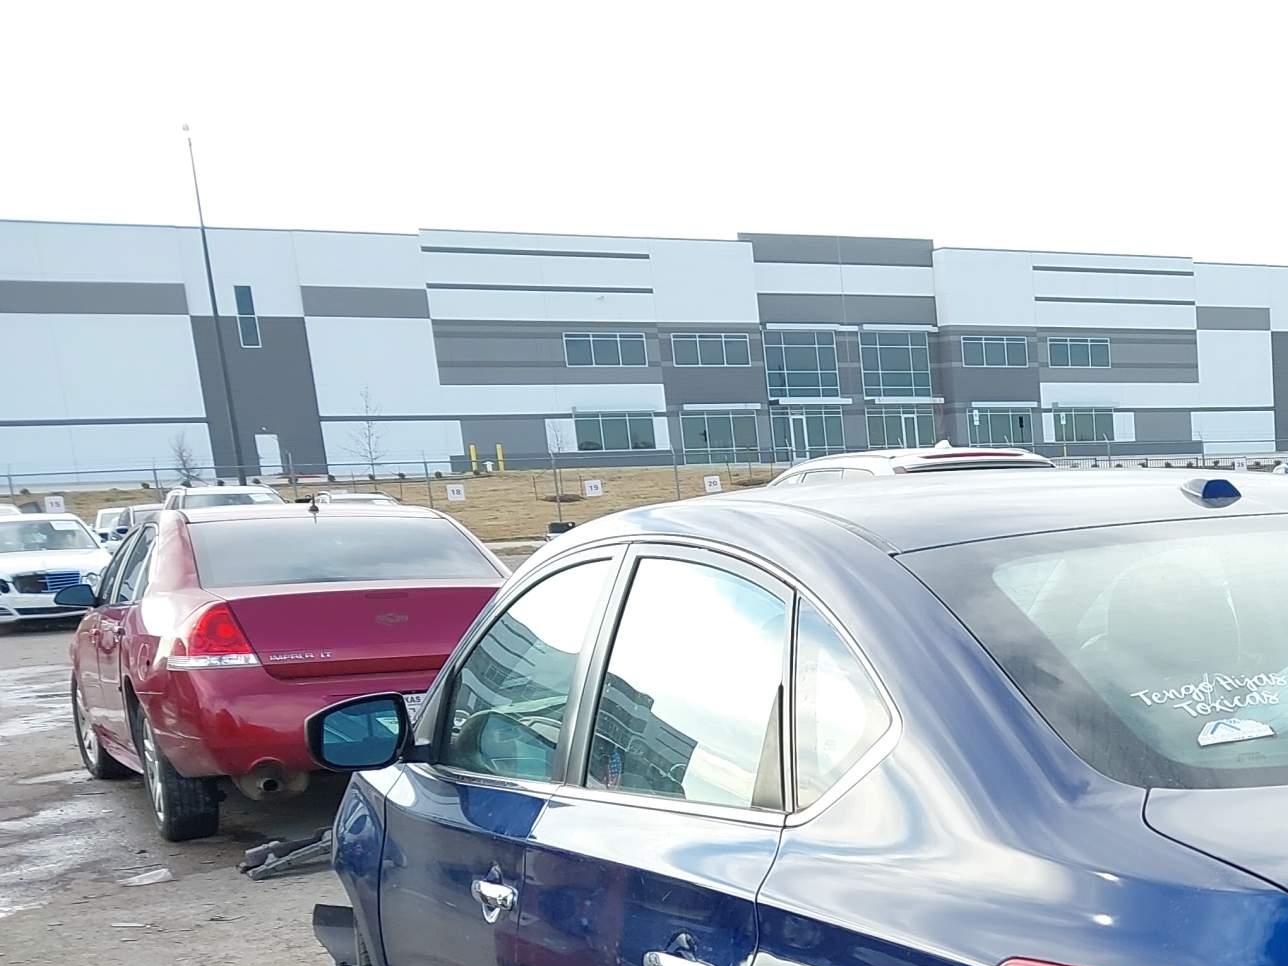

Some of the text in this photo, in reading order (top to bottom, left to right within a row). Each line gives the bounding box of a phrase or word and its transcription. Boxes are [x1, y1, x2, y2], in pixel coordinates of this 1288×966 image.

[450, 488, 461, 496] 18
[588, 484, 599, 492] 19
[1130, 680, 1214, 706] Tengo
[1173, 691, 1280, 718] Toxicas
